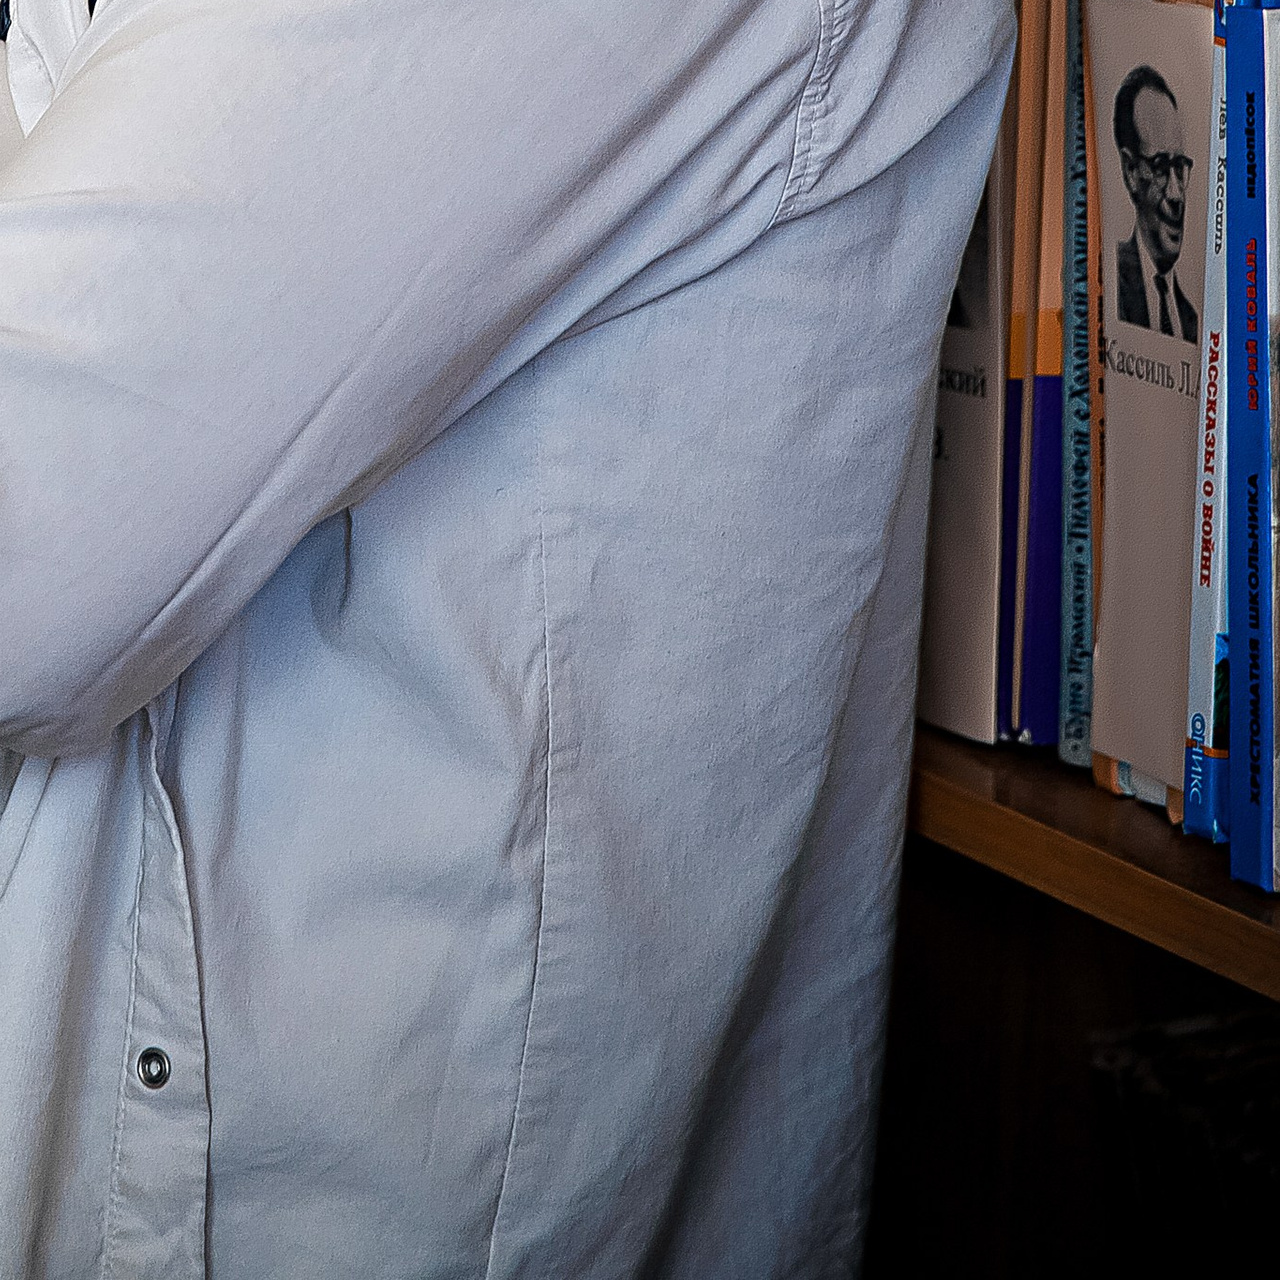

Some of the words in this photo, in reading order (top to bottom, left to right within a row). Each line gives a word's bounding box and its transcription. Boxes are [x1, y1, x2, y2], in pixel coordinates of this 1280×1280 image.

[1244, 238, 1258, 333] КОВАЛЬ
[1104, 338, 1174, 389] Кассиль
[1203, 331, 1220, 474] РАССКАЗЫ
[1244, 340, 1259, 411] ЮРИЙ
[1201, 480, 1215, 497] О
[1199, 502, 1216, 588] ВОЙНЕ
[1246, 473, 1260, 630] ШКОЛЬНИКА
[1247, 638, 1261, 805] ХРЕСТОМАТИЯ
